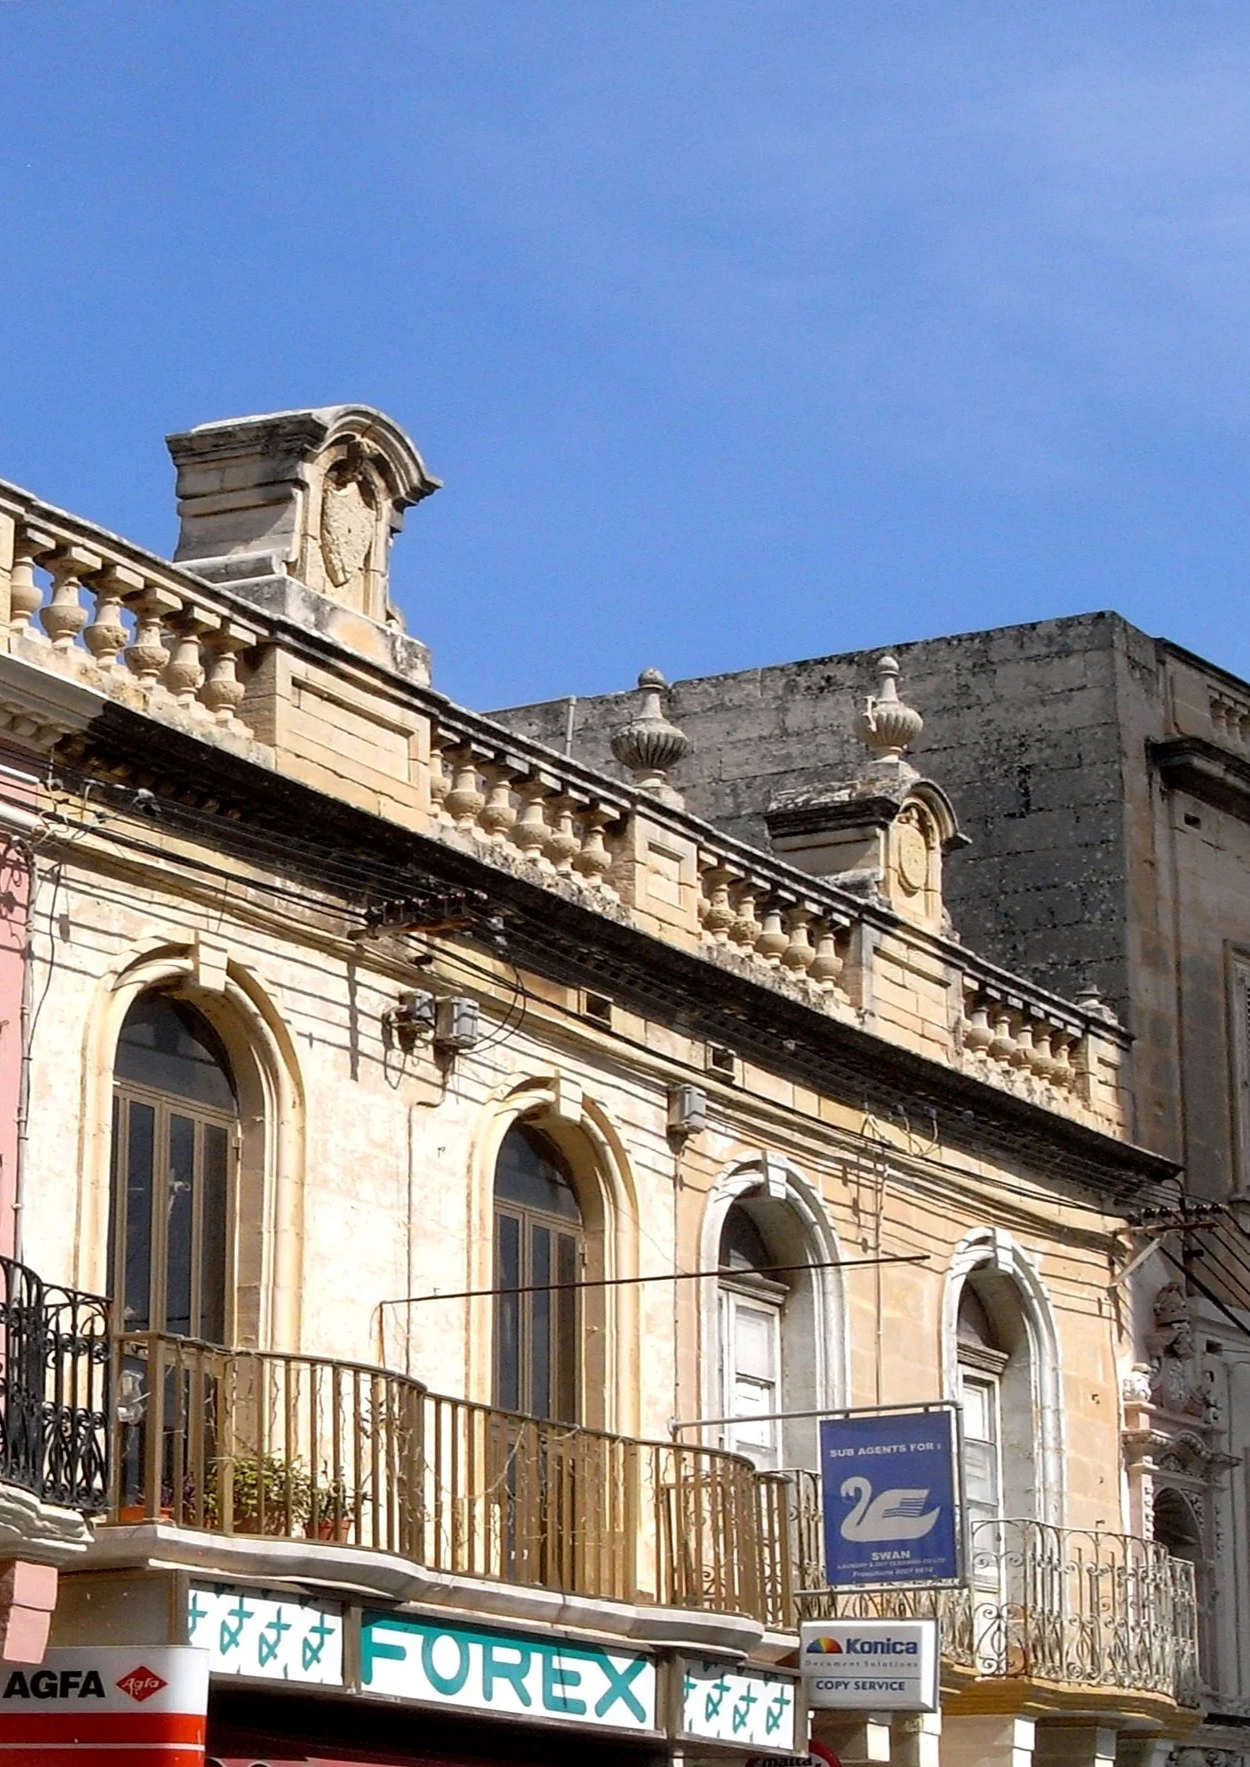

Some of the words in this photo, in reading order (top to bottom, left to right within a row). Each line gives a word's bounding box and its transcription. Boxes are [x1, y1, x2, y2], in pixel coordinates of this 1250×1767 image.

[829, 1448, 855, 1458] SUB
[857, 1444, 907, 1456] AGENTS
[910, 1442, 934, 1452] FOR
[871, 1550, 910, 1561] SWAN
[845, 1636, 918, 1655] Konica
[361, 1619, 648, 1724] FOREX
[805, 1660, 860, 1668] Document
[864, 1660, 919, 1668] Solutions
[2, 1670, 106, 1699] AGFA
[121, 1676, 160, 1696] Agfa
[815, 1680, 850, 1691] COPY
[853, 1680, 905, 1692] SERVICE
